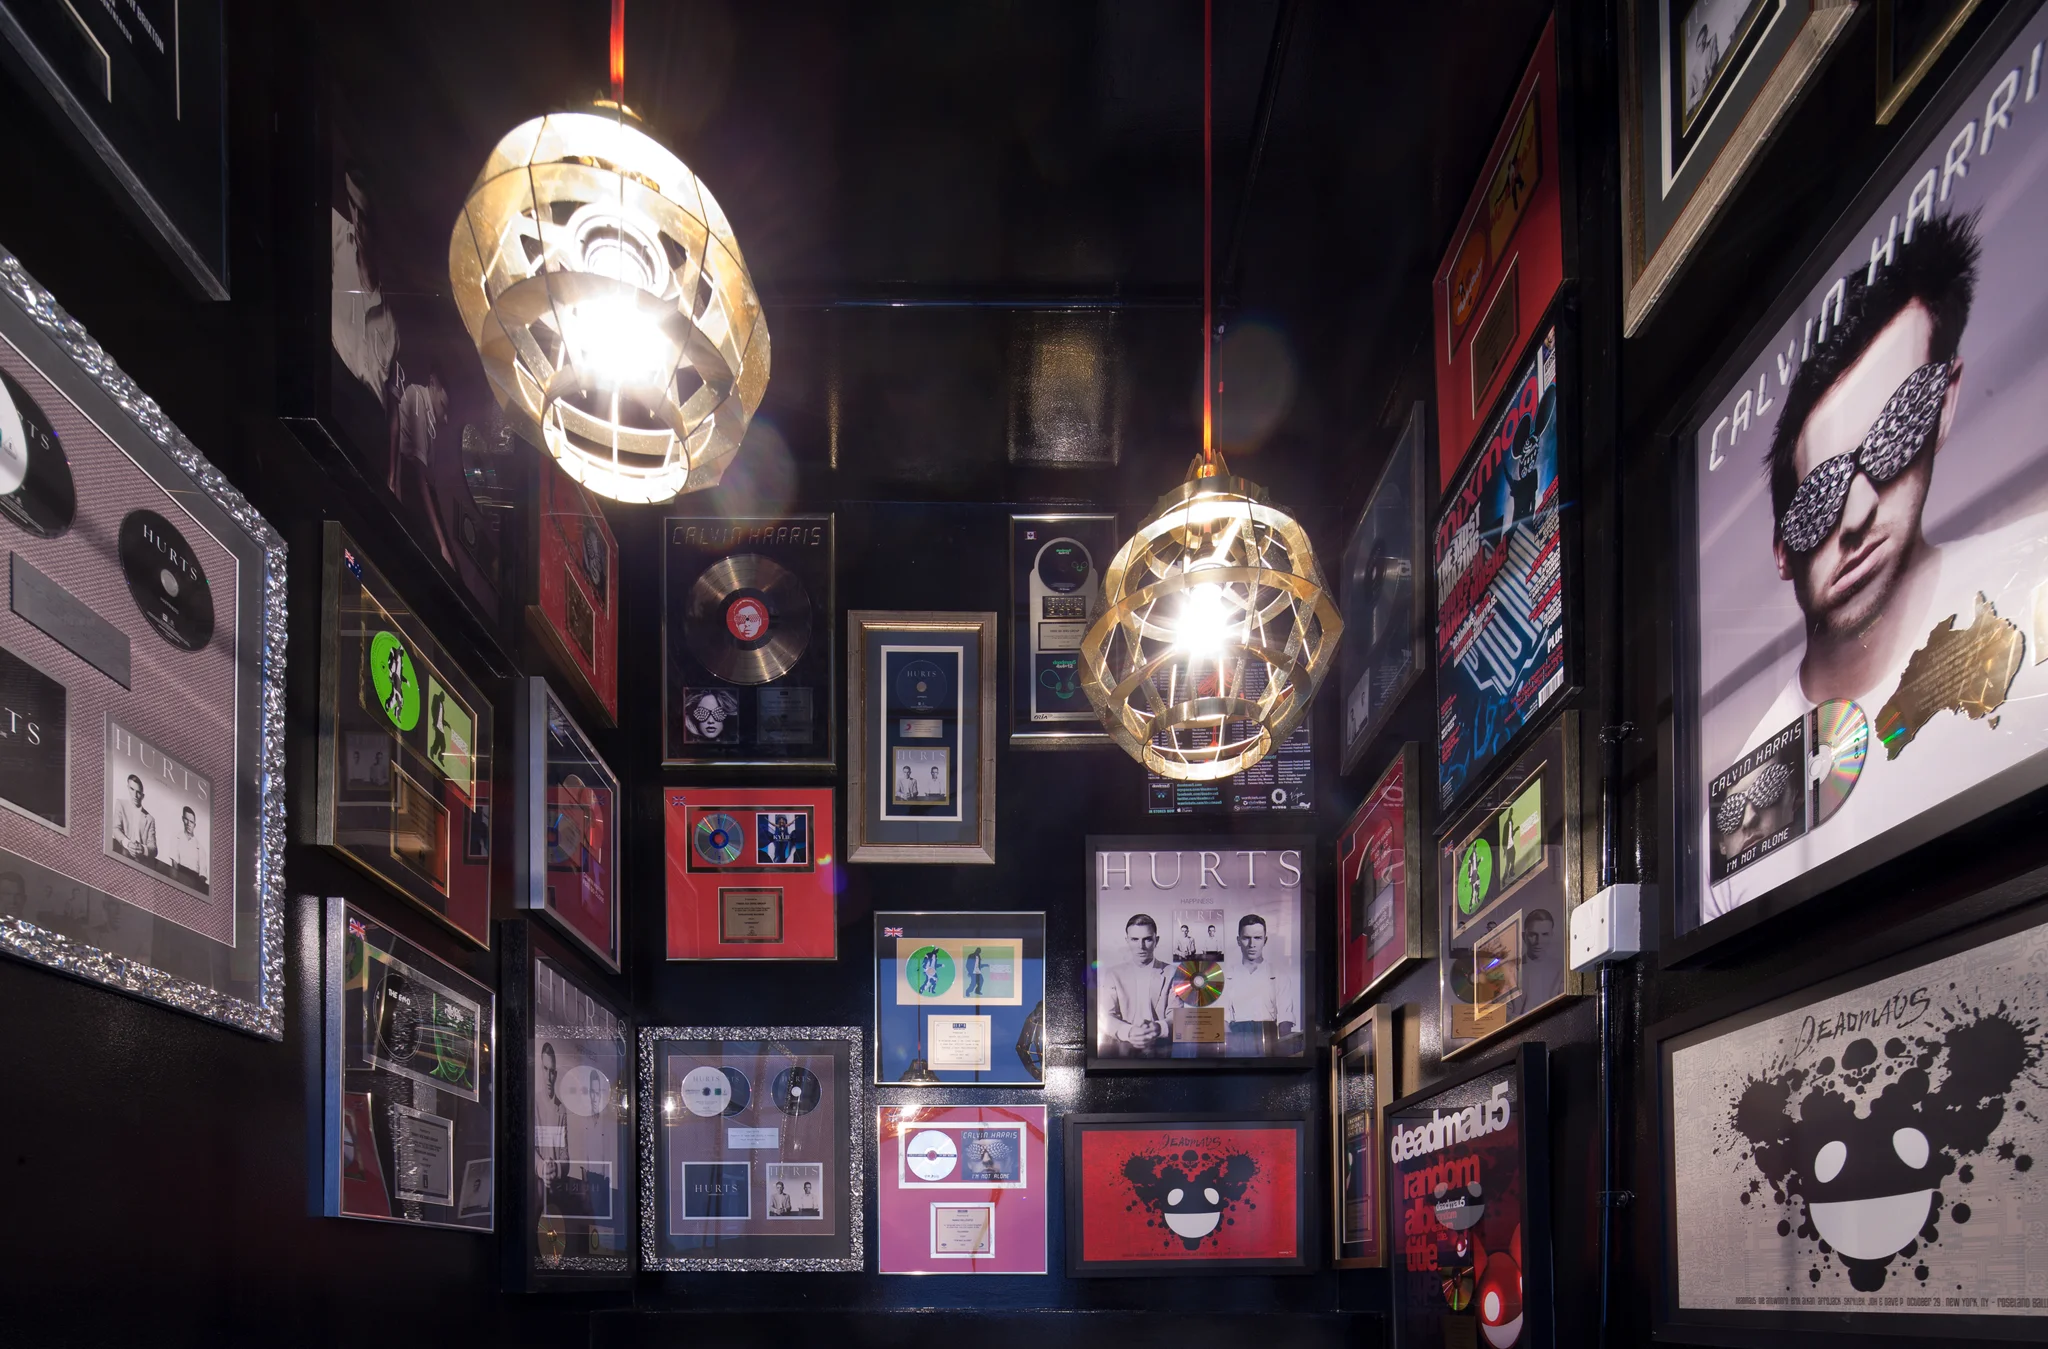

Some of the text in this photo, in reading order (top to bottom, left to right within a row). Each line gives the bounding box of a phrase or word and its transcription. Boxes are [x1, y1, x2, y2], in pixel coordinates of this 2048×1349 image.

[136, 5, 164, 54] BRIXTON
[1709, 276, 1846, 470] CALVIN
[143, 524, 197, 581] HURTS
[672, 526, 821, 546] CALVIN HARRIS
[1437, 532, 1480, 612] AMAZING
[907, 670, 937, 678] HURTS
[116, 727, 209, 801] HURTS
[897, 750, 946, 761] HURTS
[1711, 757, 1751, 799] CALVIN
[1755, 721, 1803, 764] HARRIS
[1100, 850, 1301, 891] HURTS
[1726, 827, 1790, 874] I'M NOT ALONE
[388, 988, 398, 998] THE
[537, 959, 628, 1056] HURTS
[1391, 1081, 1510, 1164] deadmau5
[695, 1184, 738, 1193] HURTS
[770, 1167, 818, 1176] HURTS
[994, 1171, 1010, 1179] ALONE
[1404, 1154, 1480, 1199] random
[1435, 1196, 1466, 1211] deadmau5
[1406, 1235, 1442, 1271] title.
